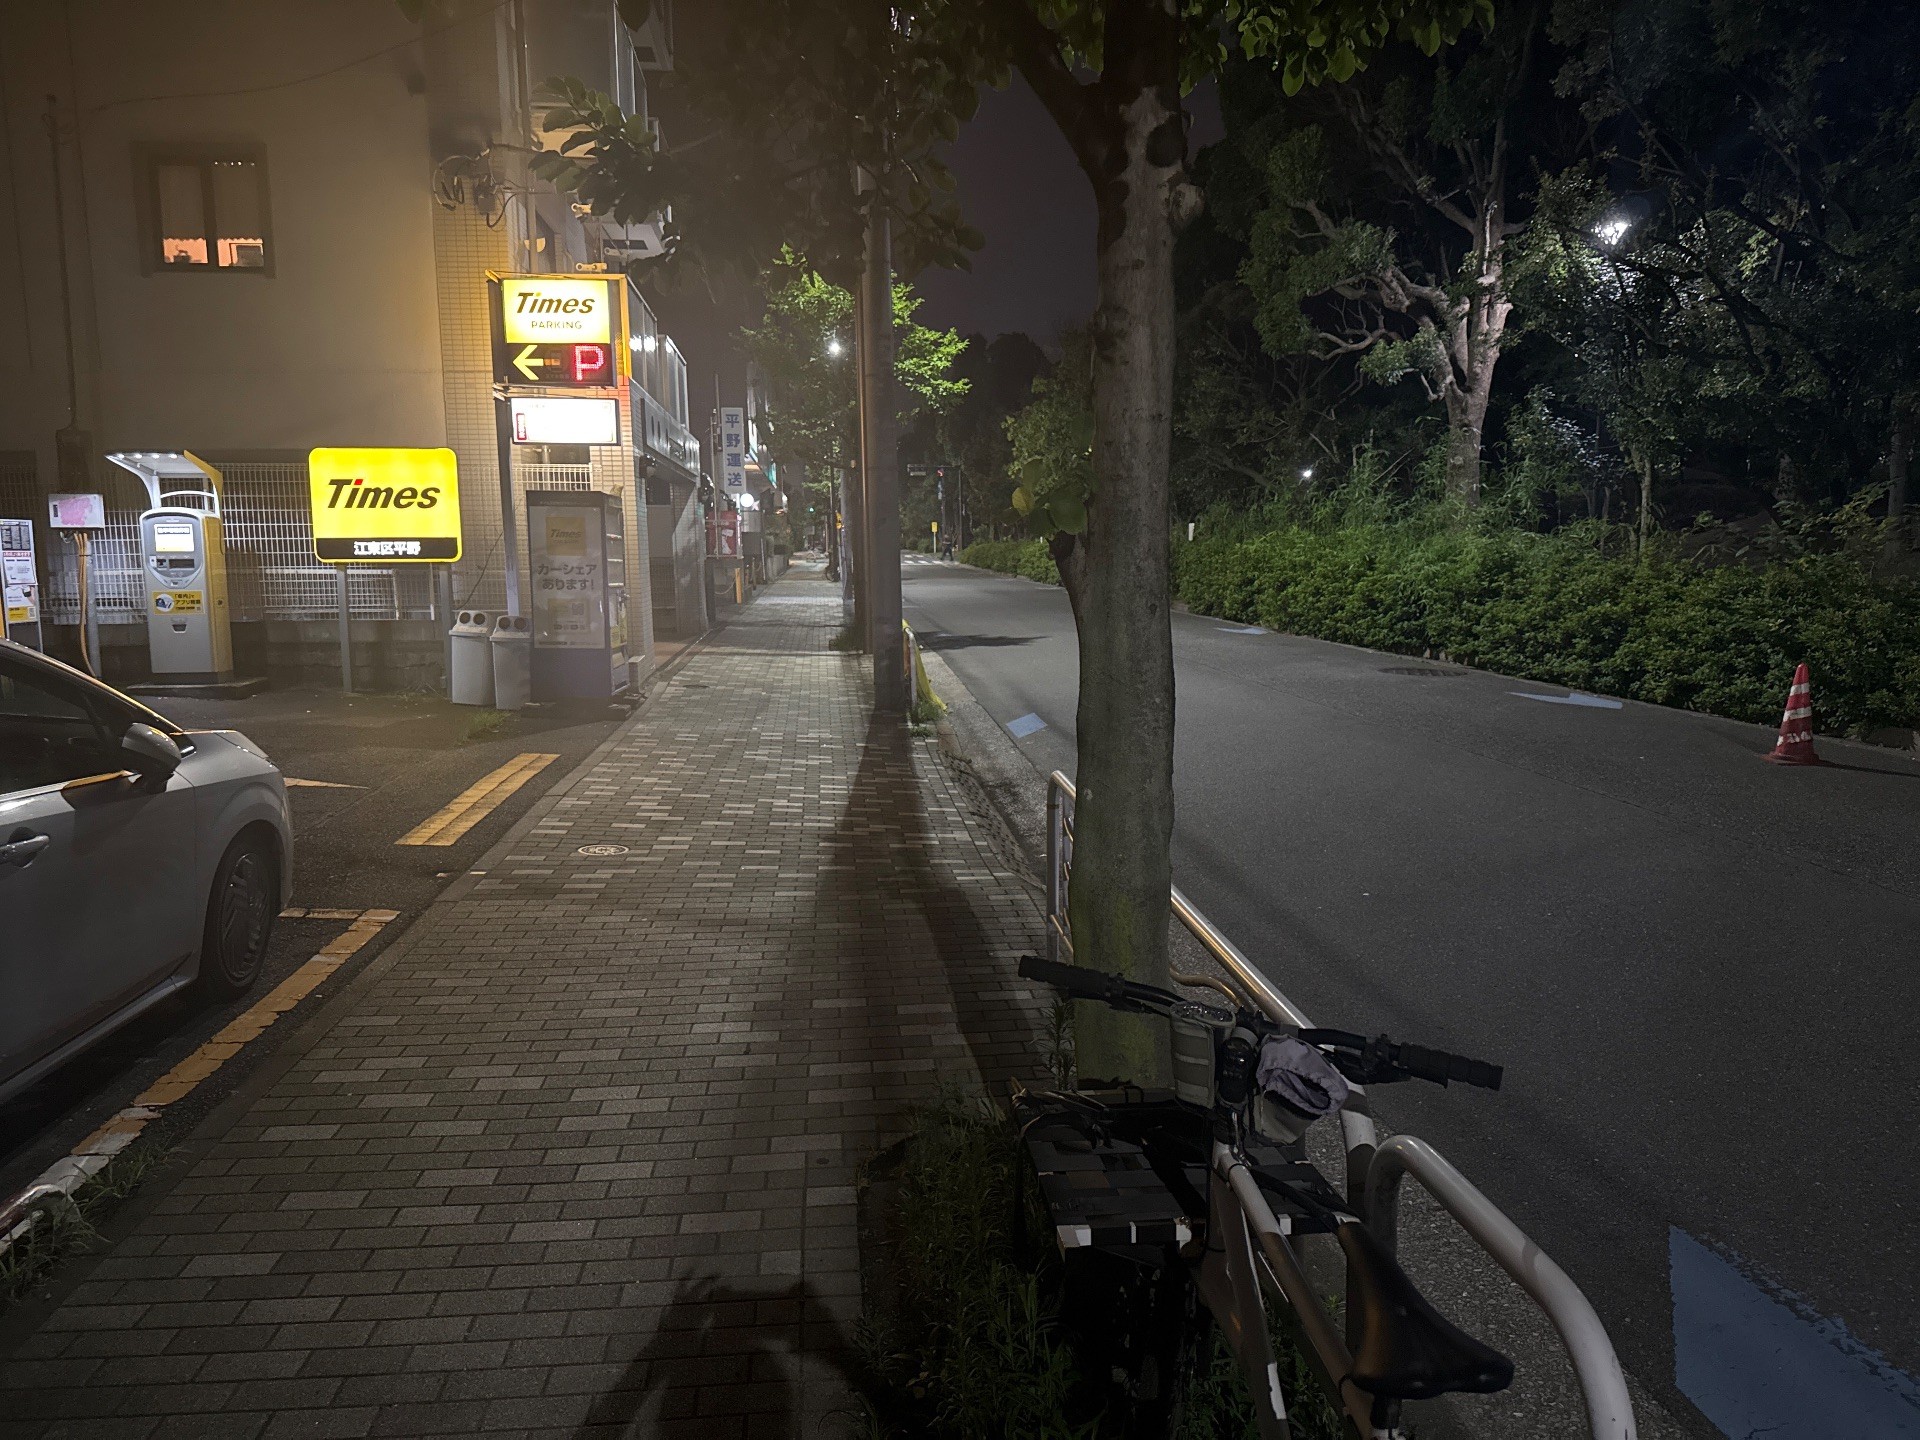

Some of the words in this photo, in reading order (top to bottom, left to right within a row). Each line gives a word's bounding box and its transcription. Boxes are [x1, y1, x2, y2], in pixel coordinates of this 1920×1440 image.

[517, 292, 595, 313] Times
[531, 321, 582, 329] PARKING
[576, 346, 603, 381] P
[725, 414, 742, 486] 平野運送
[328, 479, 440, 508] Times
[552, 529, 581, 537] Times
[537, 564, 597, 575] カーシェア
